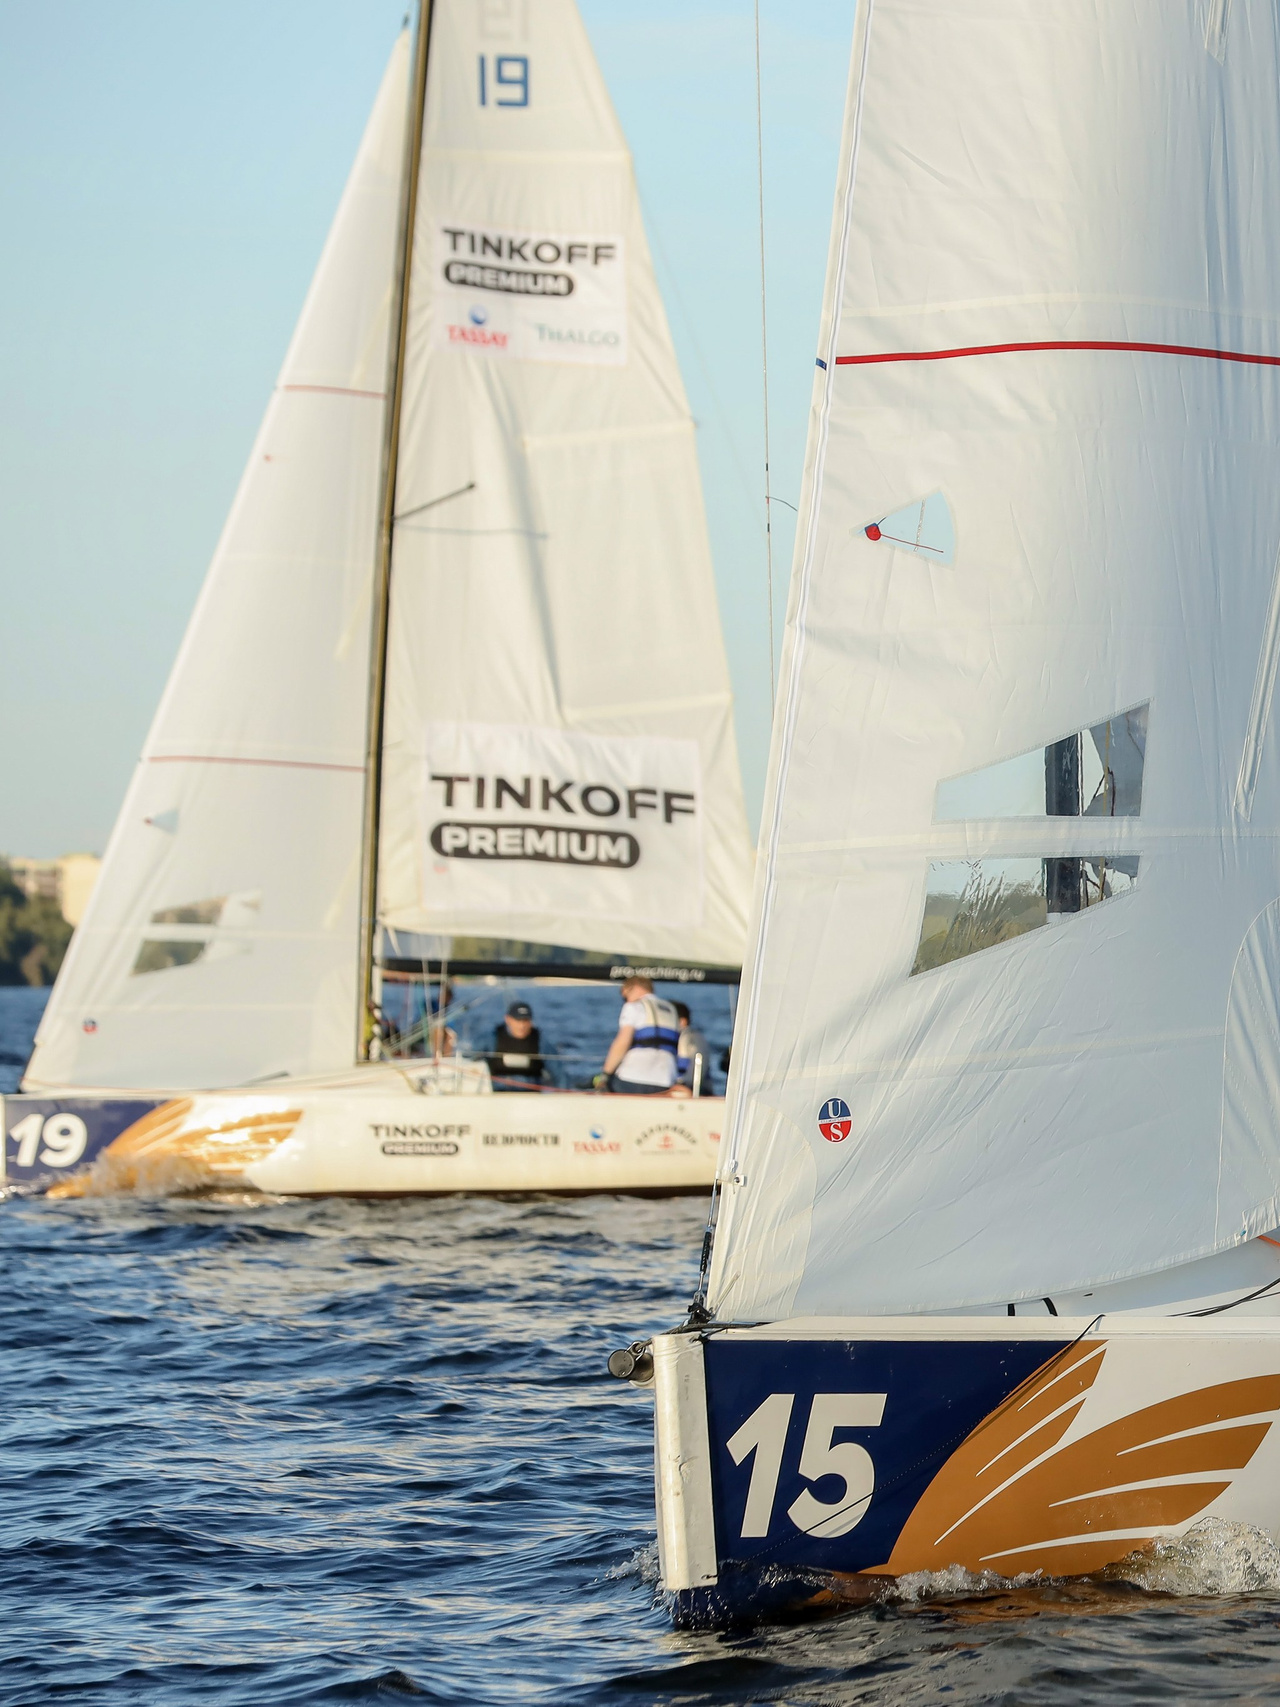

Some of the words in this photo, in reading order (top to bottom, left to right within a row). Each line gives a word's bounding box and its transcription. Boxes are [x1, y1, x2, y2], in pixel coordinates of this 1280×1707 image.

[478, 55, 529, 107] 19
[443, 227, 616, 265] TINKOFF
[450, 262, 570, 296] PREMIUM
[430, 775, 695, 824] TINKOFF
[440, 824, 631, 864] PREMIUM
[827, 1100, 842, 1118] U
[9, 1112, 88, 1168] 19
[369, 1123, 471, 1138] TINKOFF
[830, 1122, 844, 1141] S
[726, 1393, 888, 1538] 15
